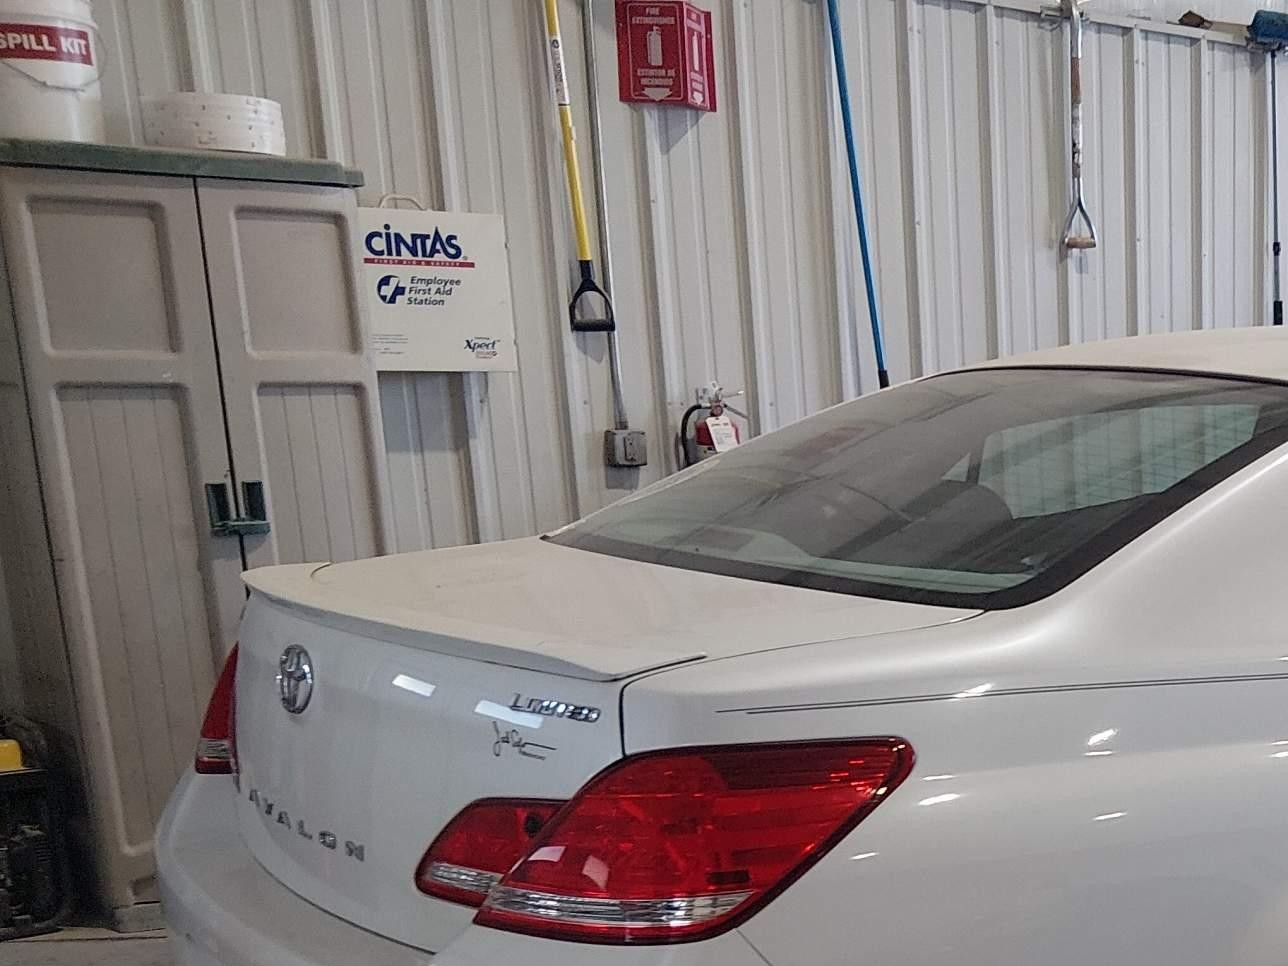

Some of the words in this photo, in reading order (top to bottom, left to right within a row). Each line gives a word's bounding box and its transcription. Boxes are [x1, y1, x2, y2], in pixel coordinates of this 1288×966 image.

[60, 36, 87, 55] KIT
[365, 223, 462, 260] CINTAS
[410, 276, 462, 287] Employee
[408, 286, 431, 295] First
[433, 287, 453, 296] Aid
[407, 296, 445, 306] Station
[248, 788, 365, 862] AVALON
